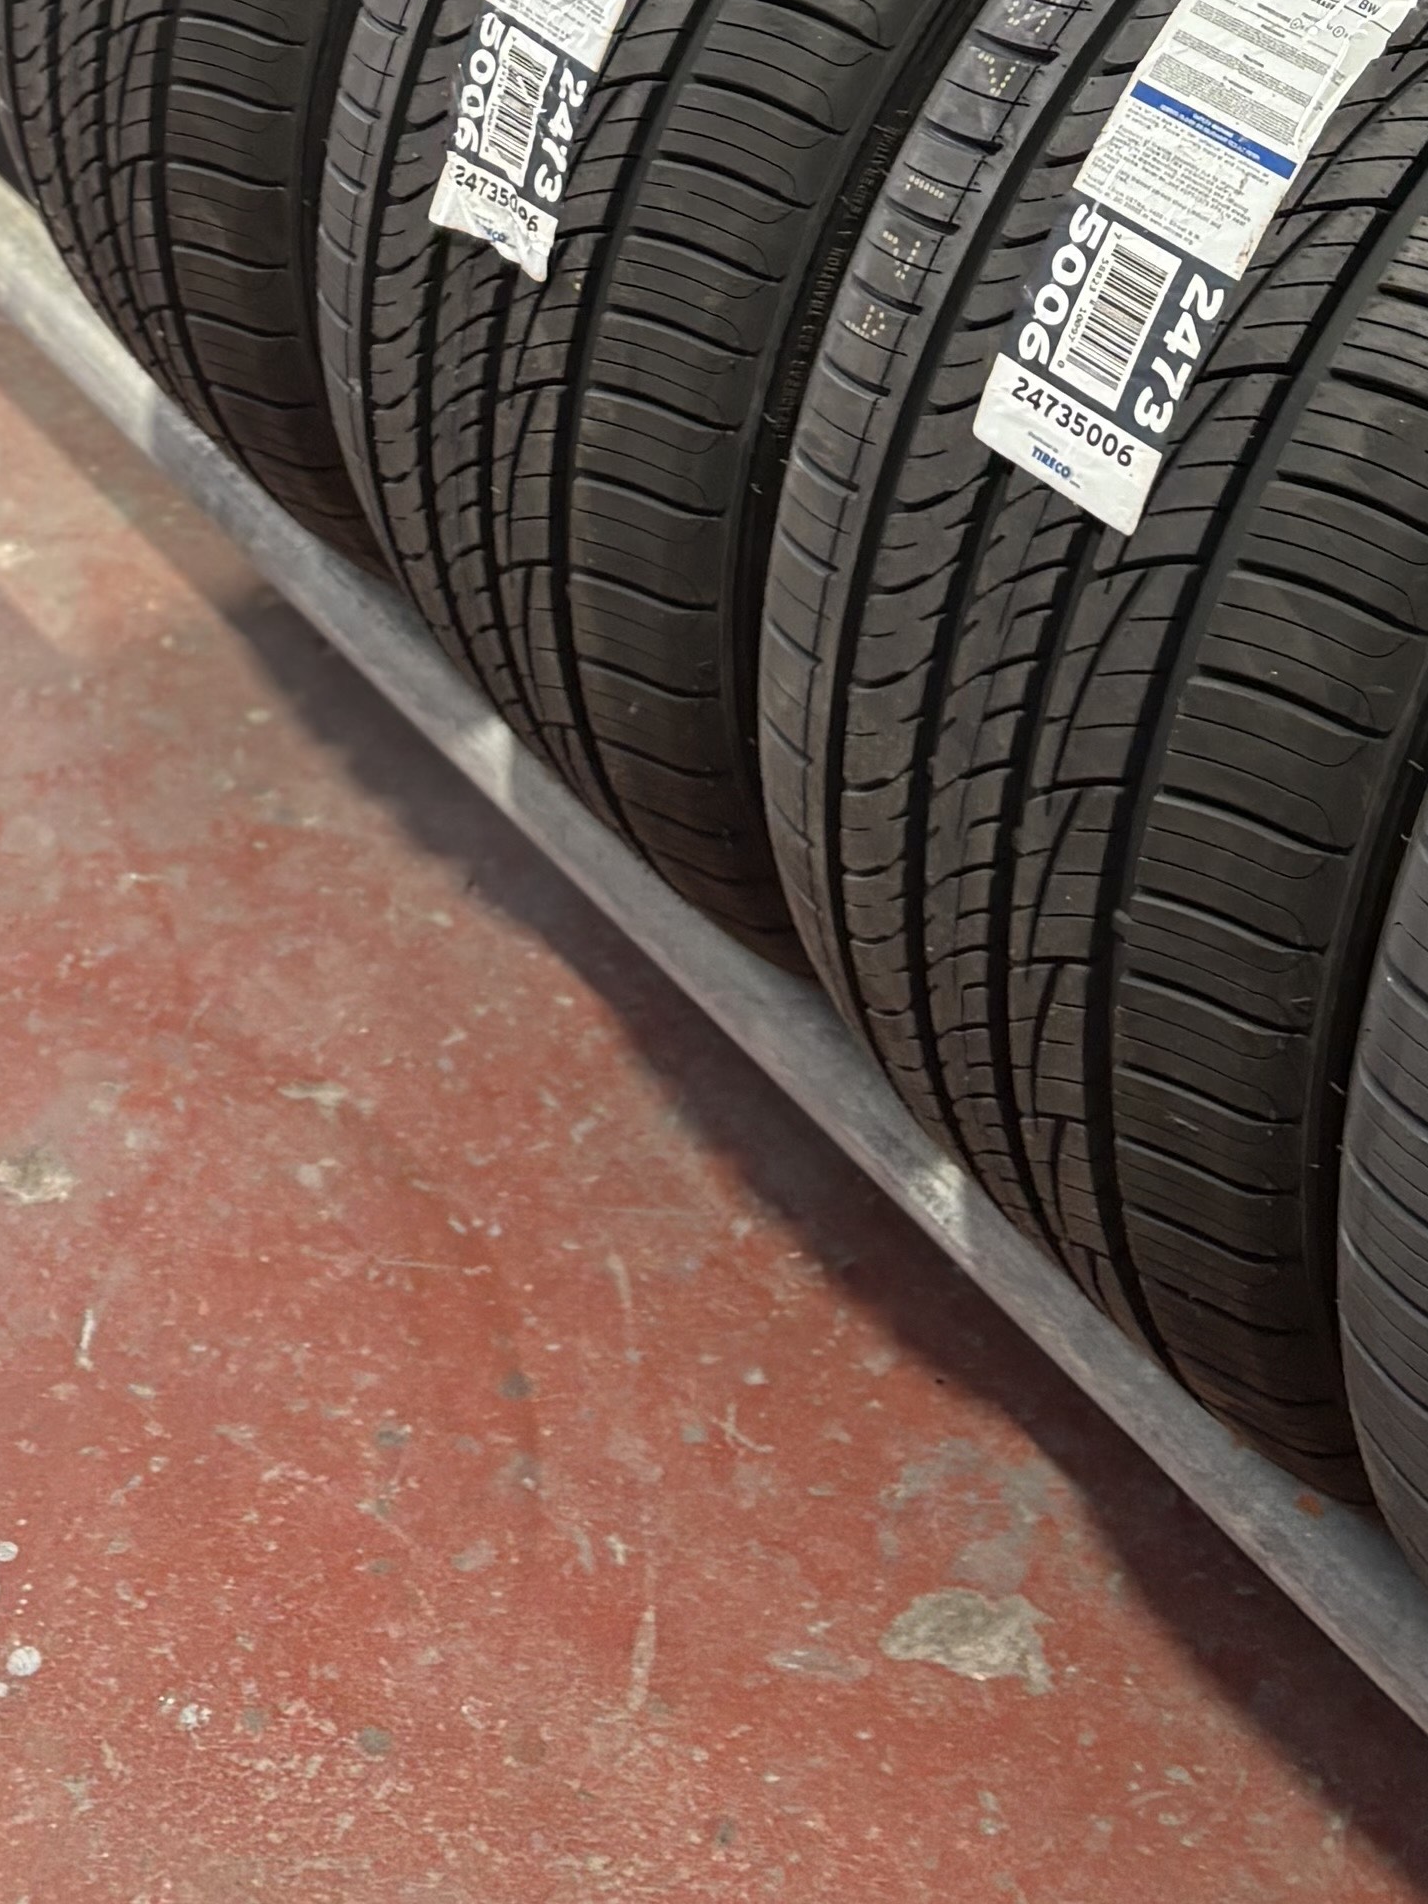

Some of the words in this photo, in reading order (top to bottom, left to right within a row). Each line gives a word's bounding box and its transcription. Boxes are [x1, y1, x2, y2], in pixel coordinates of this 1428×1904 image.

[535, 66, 586, 203] 2473
[457, 163, 539, 234] 24735006
[1016, 202, 1100, 364] 5006
[1132, 273, 1225, 435] 2473
[1010, 377, 1134, 467] 24735006
[1032, 445, 1072, 481] TIRECO
